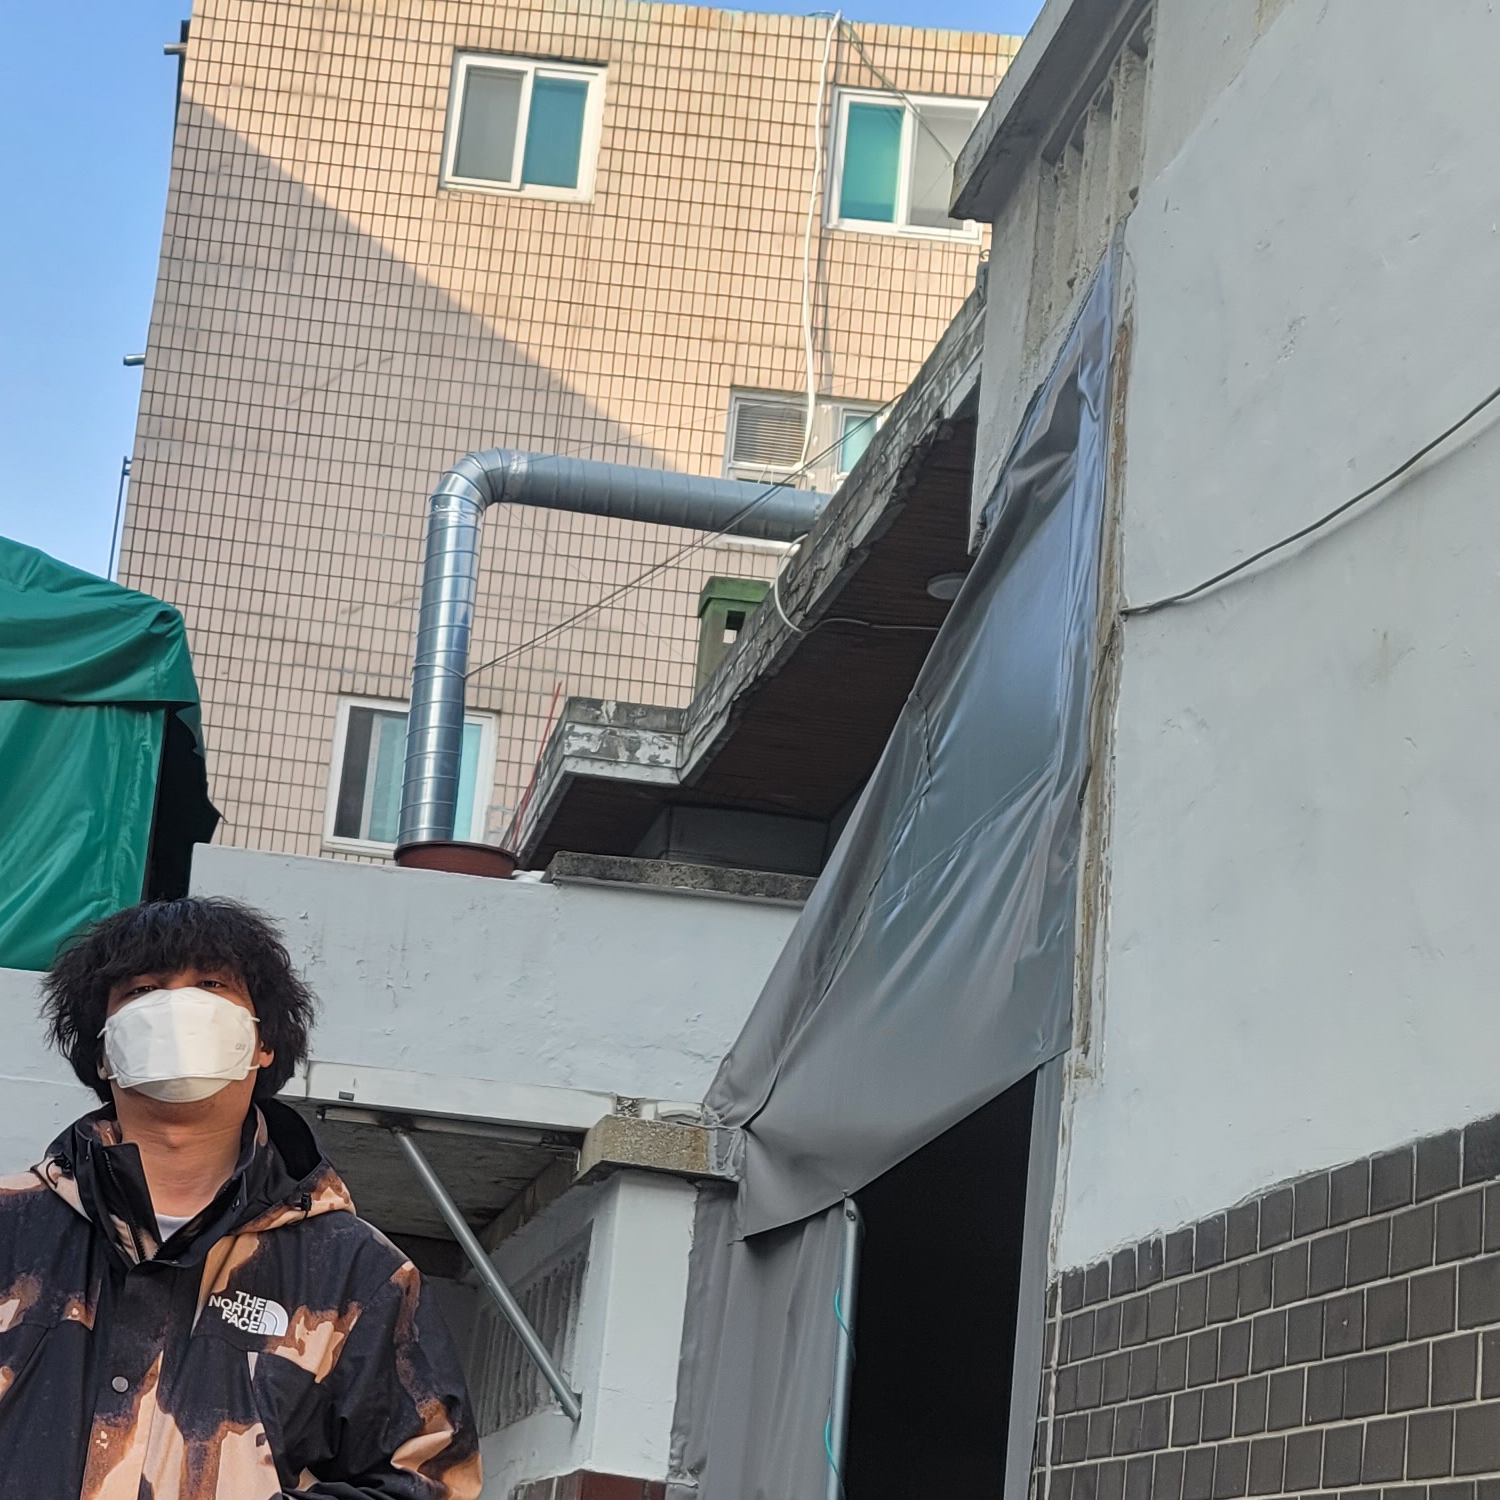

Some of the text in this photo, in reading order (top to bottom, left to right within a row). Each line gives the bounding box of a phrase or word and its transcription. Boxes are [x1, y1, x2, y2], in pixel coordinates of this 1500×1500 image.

[208, 1294, 263, 1323] NORTH
[235, 1290, 267, 1311] THE
[221, 1308, 260, 1334] FACE
